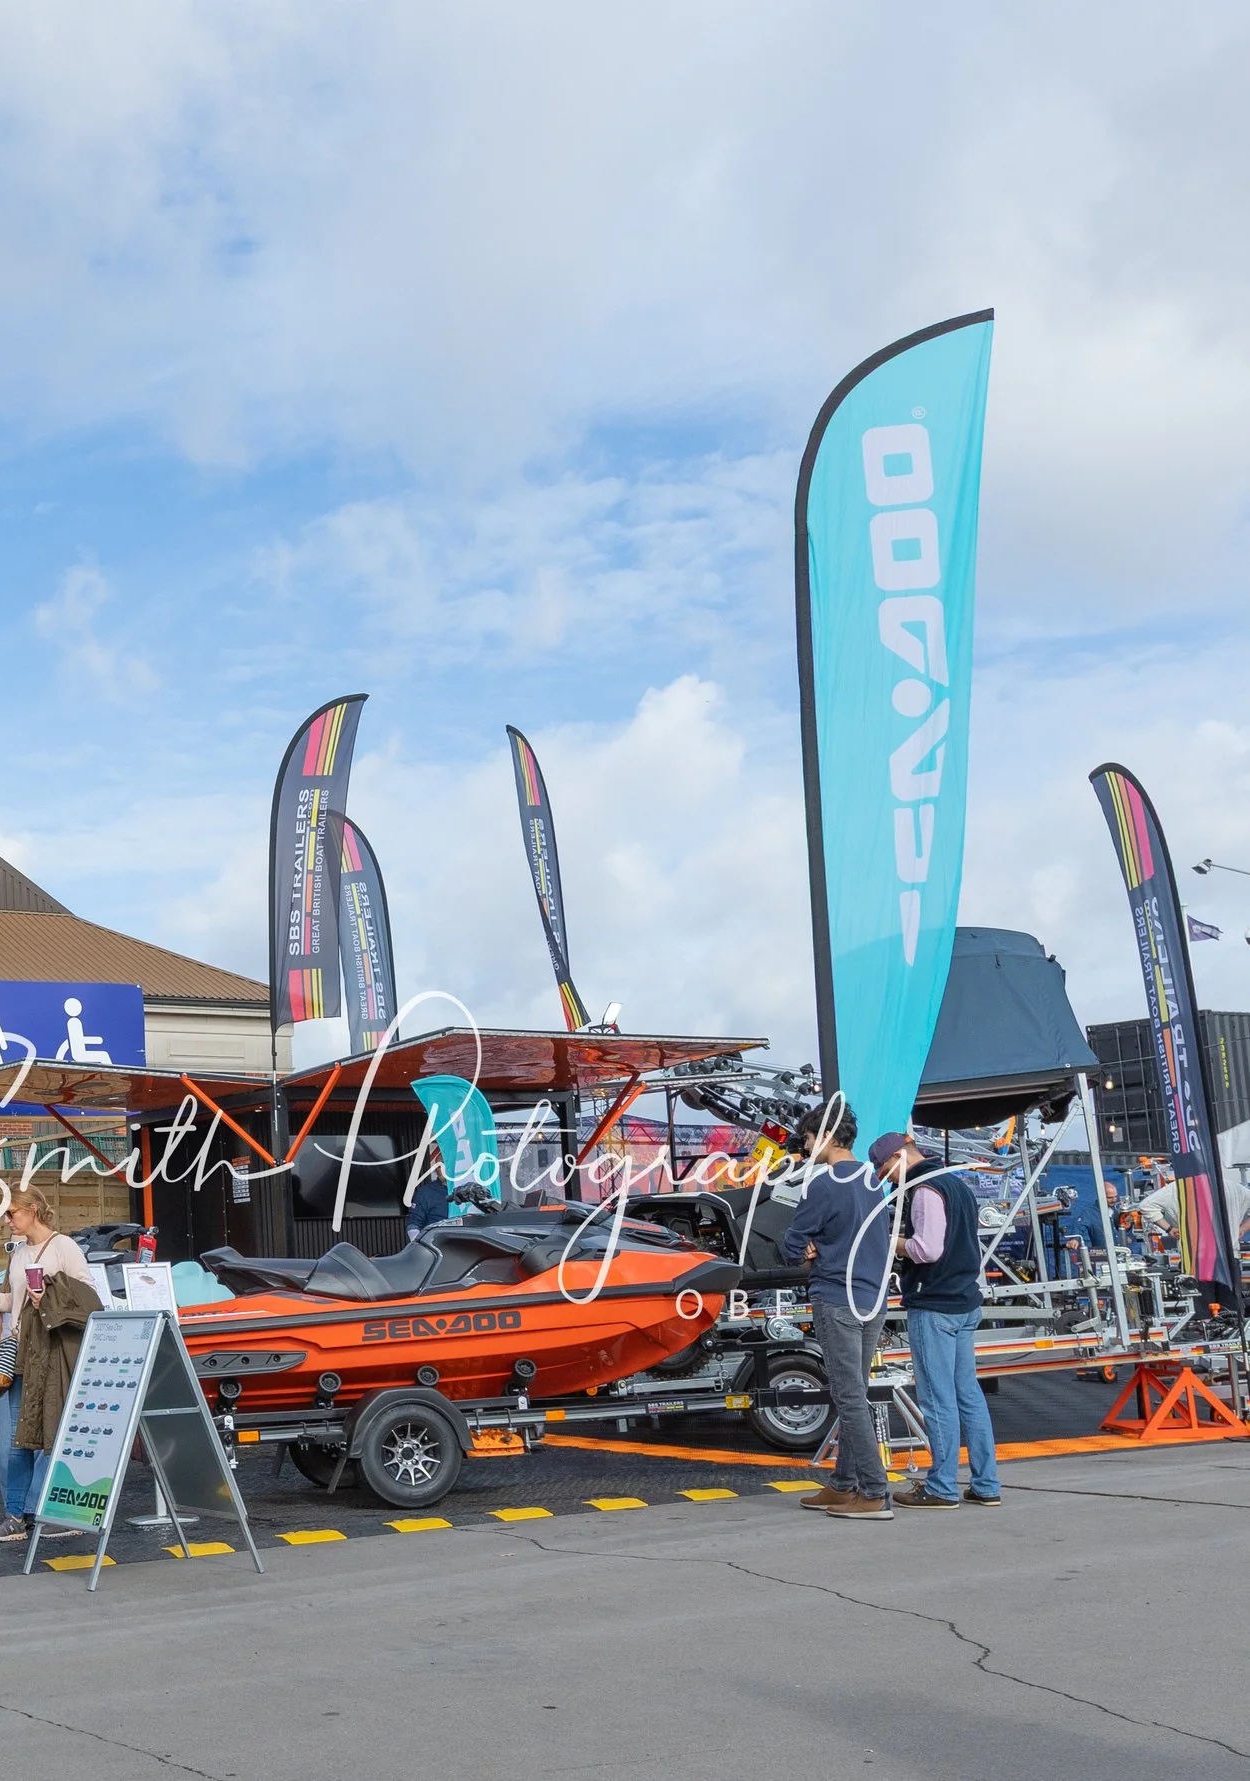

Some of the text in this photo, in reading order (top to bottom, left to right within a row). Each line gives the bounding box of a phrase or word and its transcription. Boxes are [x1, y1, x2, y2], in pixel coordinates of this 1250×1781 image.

[288, 788, 310, 956] SBS TRAILERS
[312, 789, 329, 954] GREAT BRITISH BOAT TRAILERS
